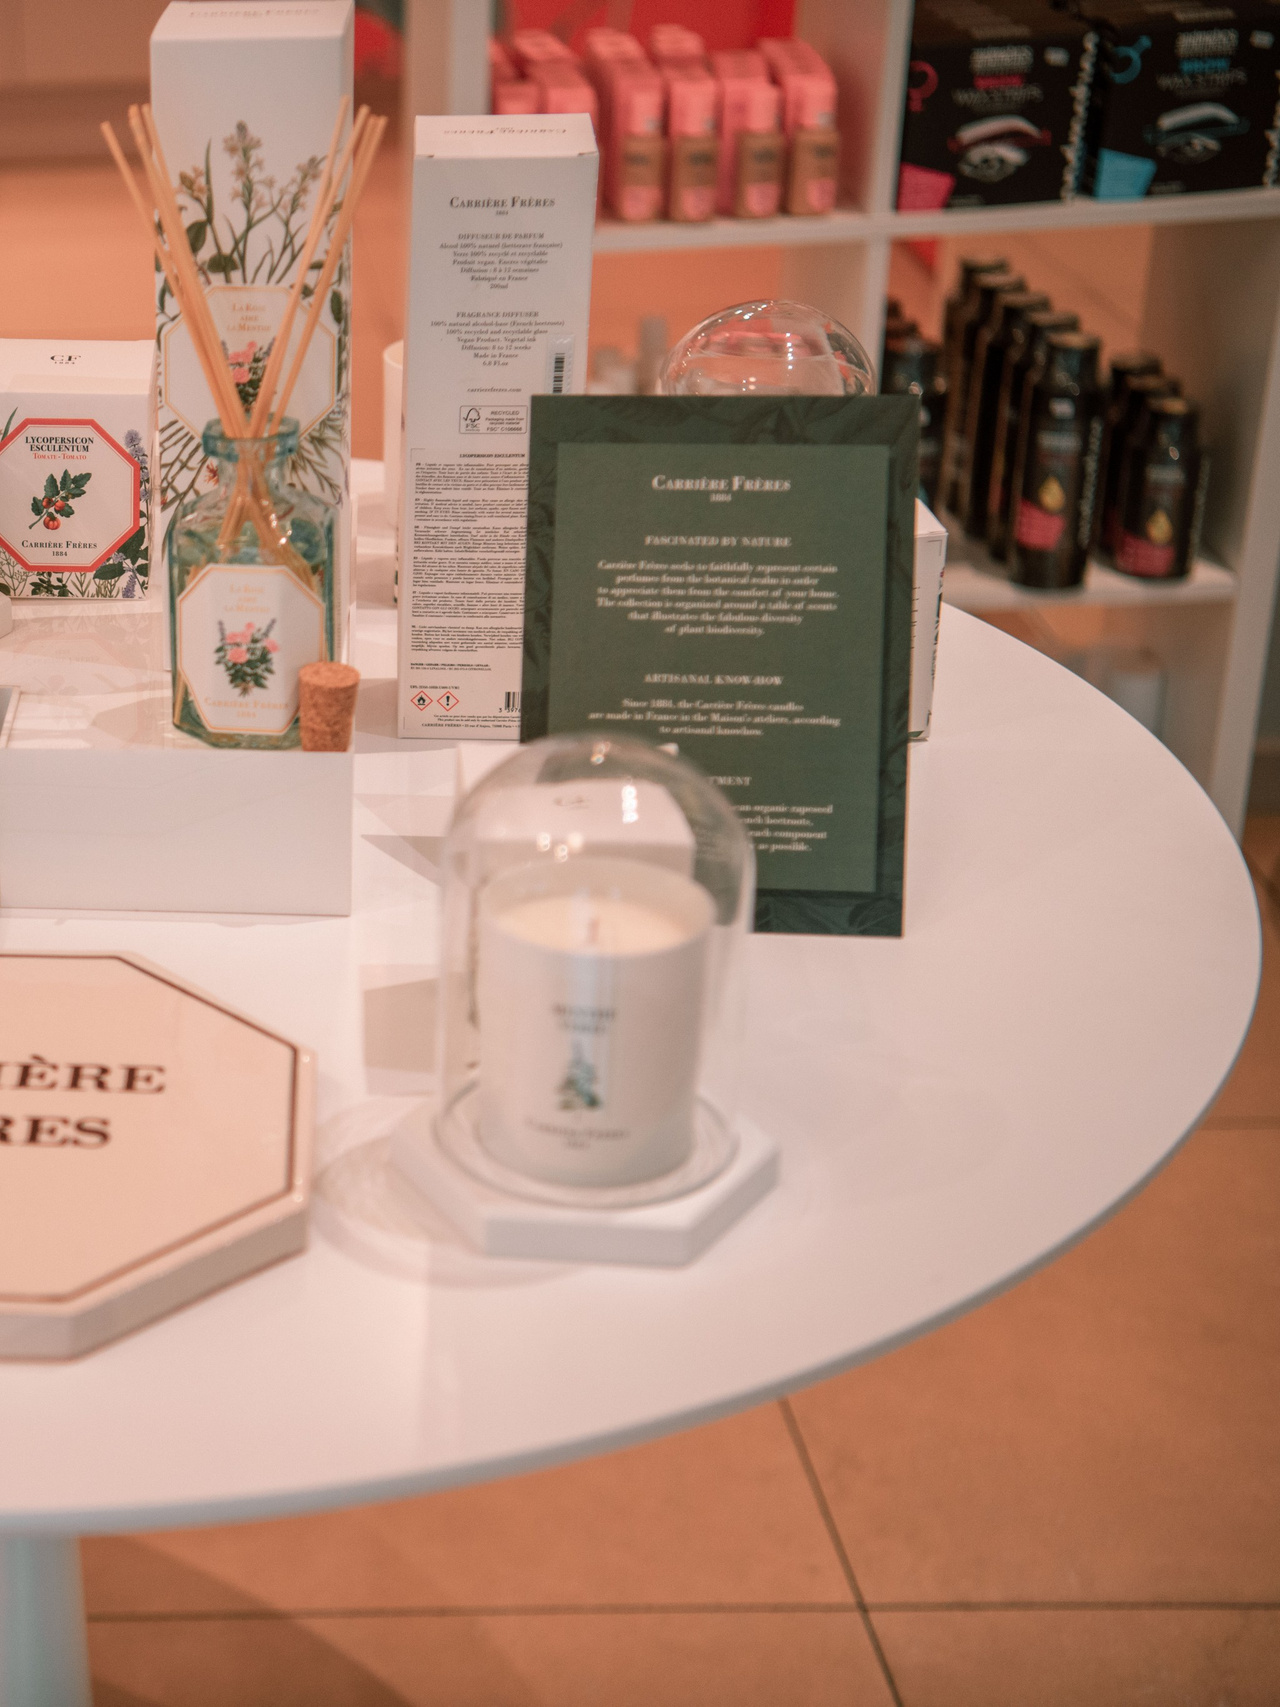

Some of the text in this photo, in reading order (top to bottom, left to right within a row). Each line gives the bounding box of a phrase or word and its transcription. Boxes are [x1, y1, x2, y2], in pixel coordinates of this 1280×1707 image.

[449, 195, 556, 209] CARRIÈRE FRÈRES
[25, 436, 94, 445] LYCOPERSICON
[30, 444, 90, 453] ESCULENTUM
[652, 475, 792, 492] CARRIÈRE FRÈRES
[22, 540, 98, 549] CARRIÈRE FRÈRES
[644, 535, 792, 548] FASCINATED BY NATURE
[697, 563, 707, 572] to
[708, 561, 754, 574] faithfully
[756, 564, 800, 575] represent
[802, 564, 838, 574] certain
[662, 574, 684, 584] from
[687, 574, 702, 584] the
[704, 575, 749, 584] botanical
[751, 576, 780, 585] realm
[781, 576, 792, 585] in
[794, 576, 819, 586] order
[597, 586, 608, 595] to
[611, 586, 658, 598] appreciate
[660, 587, 686, 596] them
[688, 588, 711, 596] from
[713, 588, 730, 597] the
[731, 588, 769, 598] comfort
[771, 588, 782, 598] of
[784, 590, 808, 600] your
[596, 598, 615, 608] The
[618, 598, 663, 608] collection
[665, 599, 672, 608] is
[674, 600, 720, 610] organized
[722, 600, 757, 610] around
[768, 602, 790, 610] table
[790, 602, 804, 610] of
[628, 610, 650, 620] that
[652, 611, 698, 621] illustrates
[700, 612, 716, 621] the
[762, 614, 804, 626] diversity
[665, 624, 677, 634] of
[678, 624, 705, 636] plant
[644, 673, 784, 686] ARTISANAL KNOW-HOW
[622, 698, 648, 708] Since
[678, 699, 694, 708] the
[696, 700, 734, 710] Carrière
[605, 712, 630, 720] made
[633, 712, 644, 720] in
[646, 712, 678, 721] France
[682, 713, 690, 722] in
[693, 713, 708, 722] the
[711, 713, 752, 722] Maison's
[794, 716, 841, 727] according
[660, 726, 716, 735] to artisanal
[754, 804, 788, 814] organic
[790, 805, 834, 815] rapeseed
[774, 830, 827, 840] component
[770, 842, 812, 852] possible.
